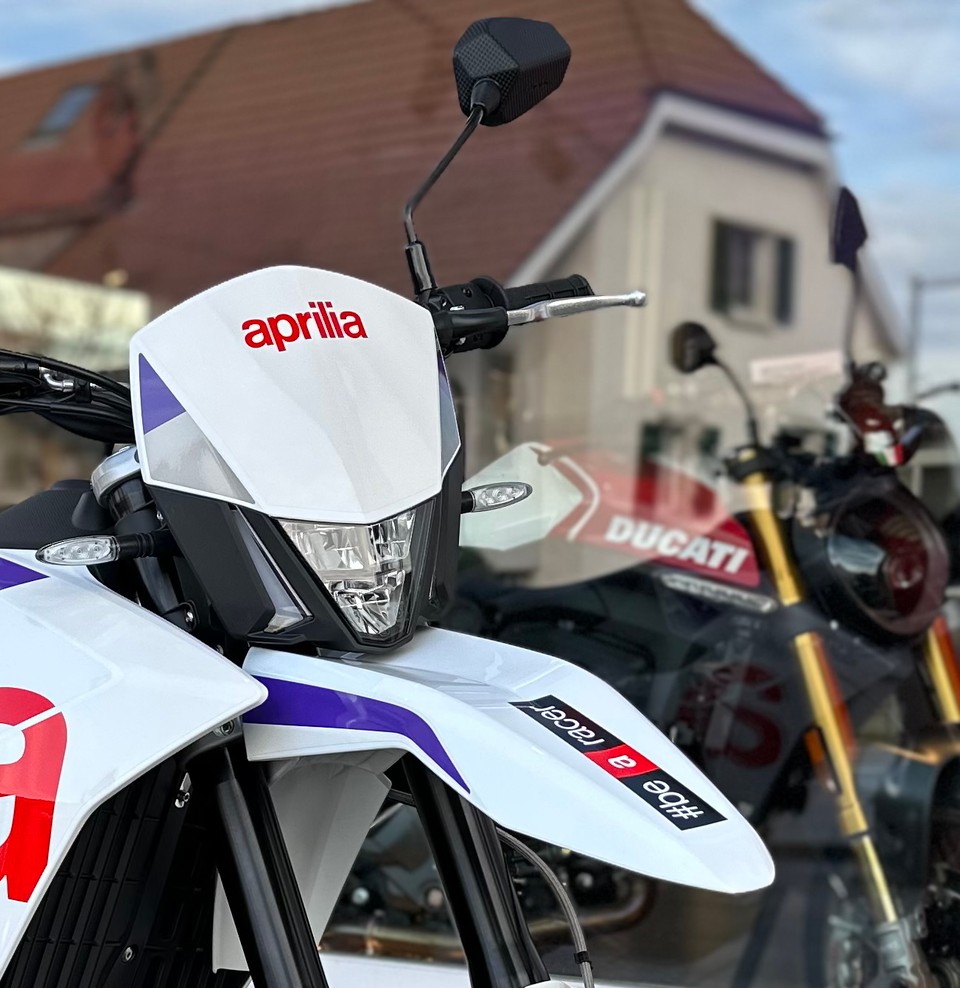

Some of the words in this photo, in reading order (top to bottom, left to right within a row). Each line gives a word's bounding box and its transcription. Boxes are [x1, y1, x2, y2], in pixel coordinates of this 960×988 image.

[242, 301, 369, 352] aprilia
[605, 514, 749, 575] DUCATI
[530, 705, 605, 747] racer
[607, 754, 637, 769] a
[642, 779, 704, 820] #be
